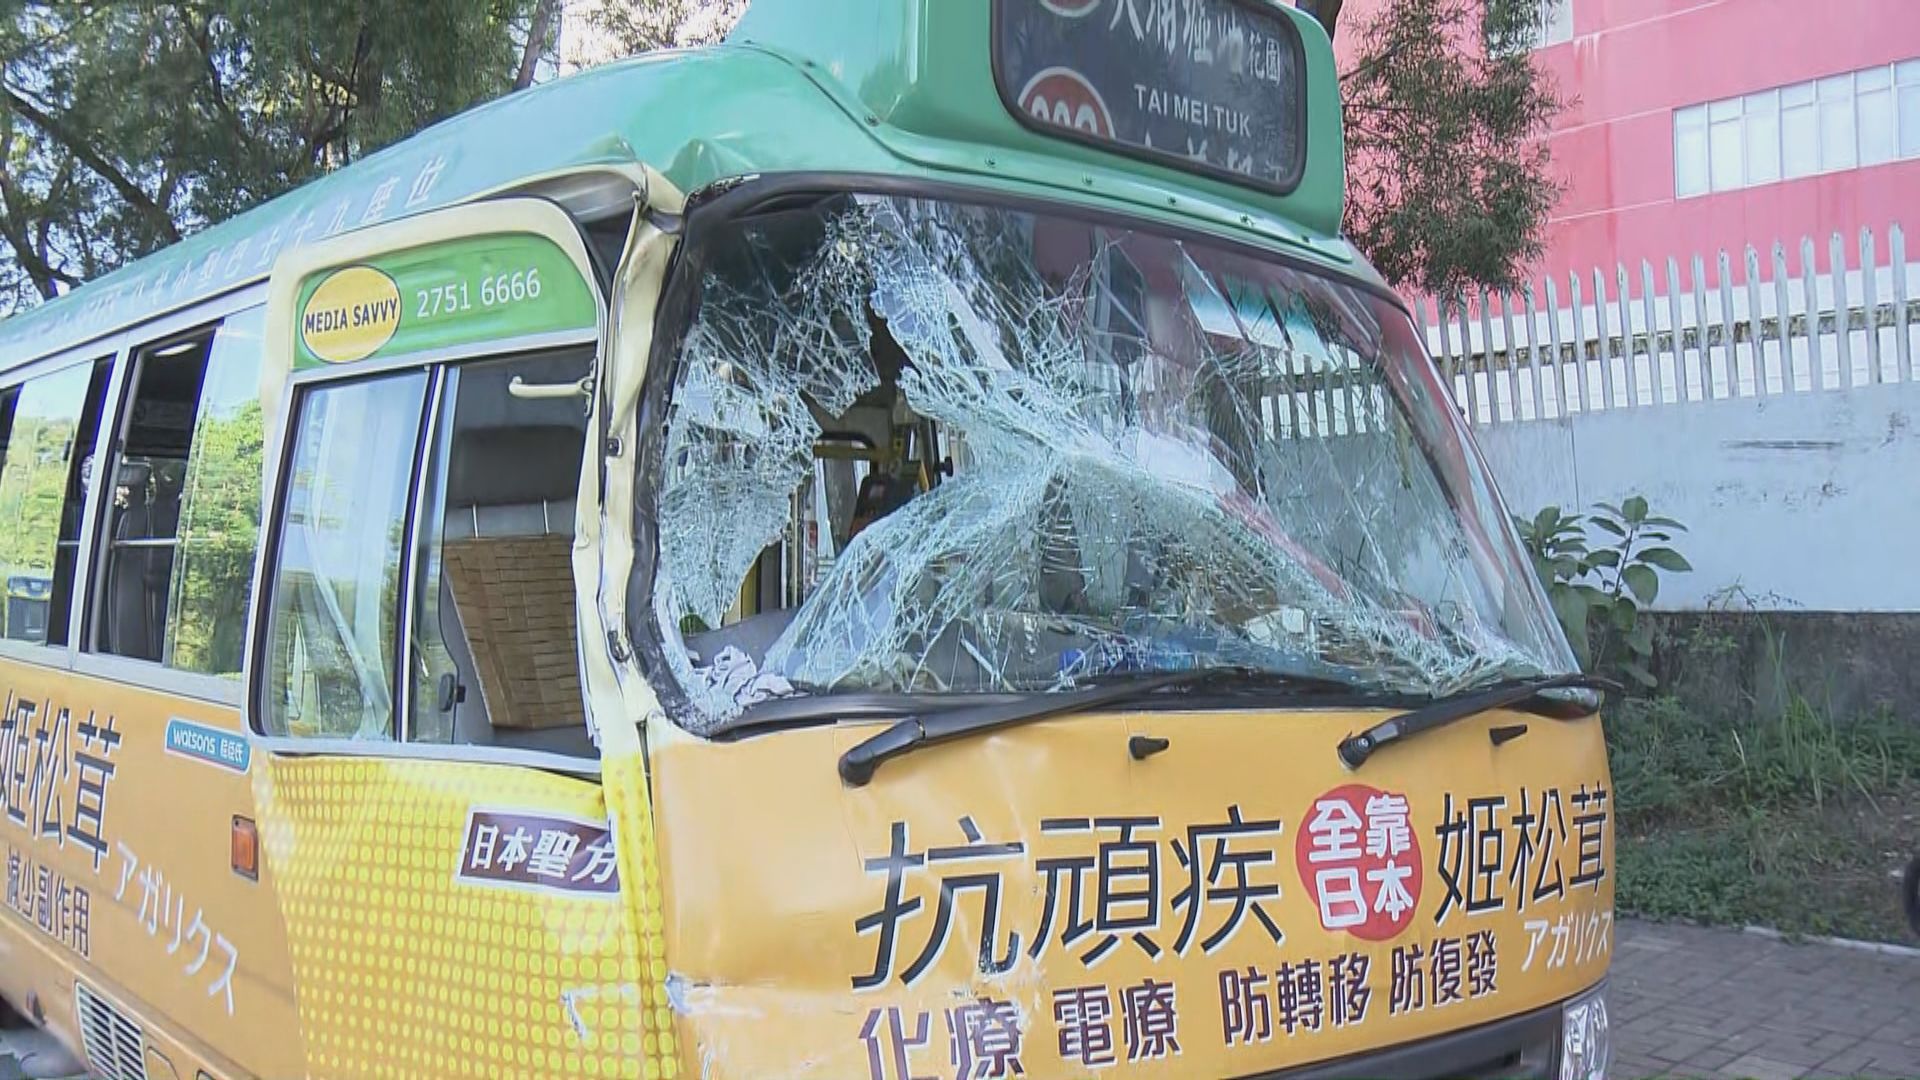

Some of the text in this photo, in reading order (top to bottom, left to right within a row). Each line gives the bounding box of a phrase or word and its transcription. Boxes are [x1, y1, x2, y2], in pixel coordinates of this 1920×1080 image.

[1134, 84, 1168, 117] TAI
[1174, 93, 1208, 127] MEI
[1214, 106, 1251, 137] TUK
[304, 297, 399, 335] MEDIA SAVVY
[416, 268, 541, 318] 2751 6666
[173, 727, 216, 755] watsons
[0, 689, 121, 870] 姬松茸
[1308, 793, 1411, 864] 全靠
[1434, 782, 1608, 927] 姬松茸
[116, 840, 239, 1017] アガリクス
[851, 803, 1284, 990] 抗頑疾
[1315, 861, 1414, 929] 日本
[1521, 908, 1612, 972] アガリクス
[858, 930, 1498, 1080] 化療 電療 防轉移 防復發
